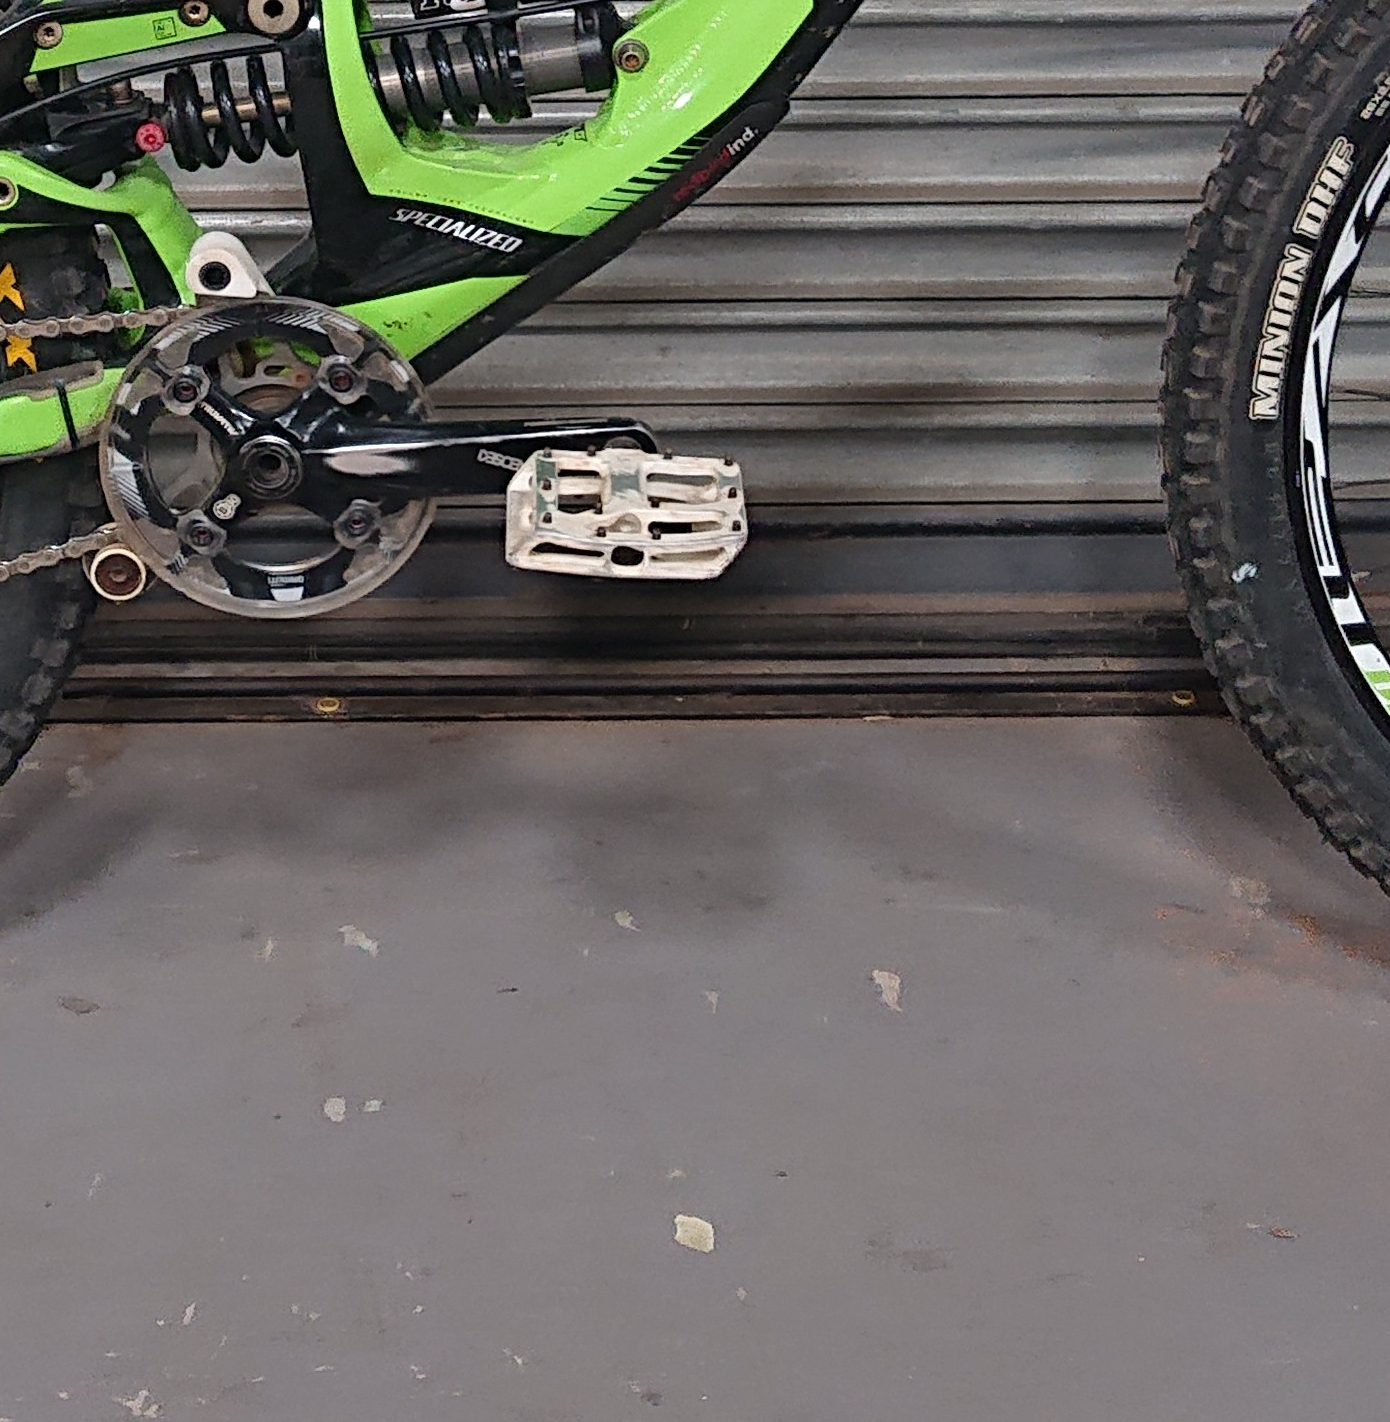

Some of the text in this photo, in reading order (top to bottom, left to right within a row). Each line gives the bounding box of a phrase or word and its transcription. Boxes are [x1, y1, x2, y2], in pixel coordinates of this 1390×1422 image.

[388, 207, 524, 253] SPECIALIZED
[1248, 243, 1312, 420] MINION
[1293, 135, 1355, 240] DHF
